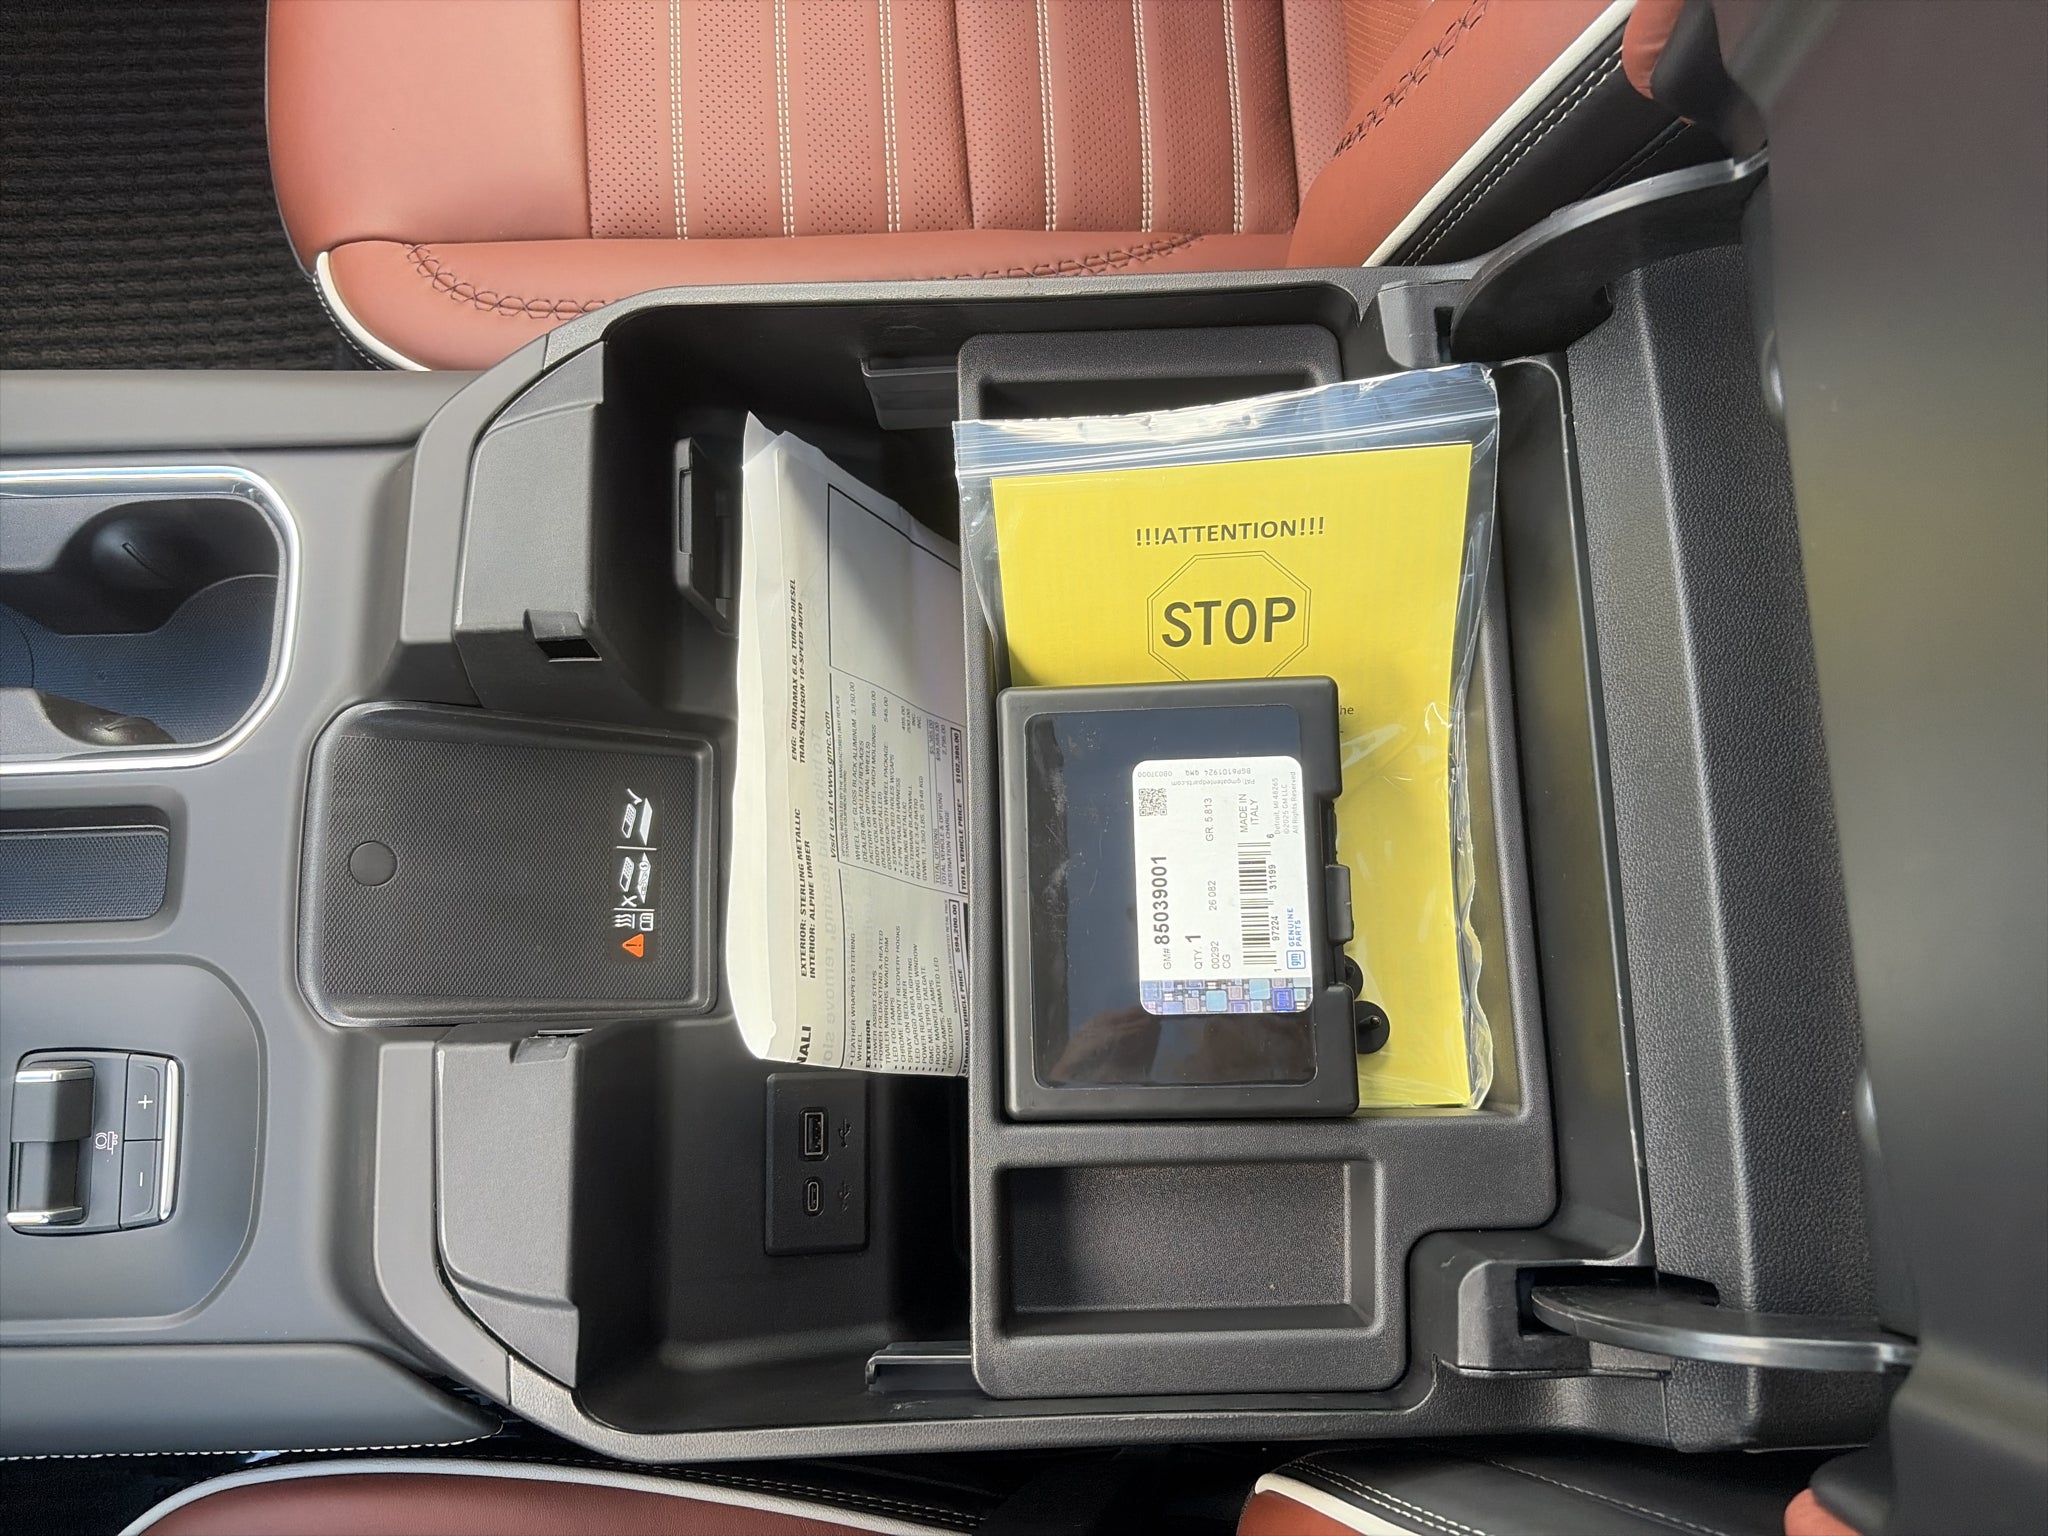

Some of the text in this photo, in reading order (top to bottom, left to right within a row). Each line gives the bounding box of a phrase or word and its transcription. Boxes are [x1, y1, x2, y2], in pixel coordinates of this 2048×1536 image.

[1135, 516, 1325, 547] !!!ATTENTION!!!
[1161, 595, 1297, 648] STOP
[790, 654, 798, 675] 6.6L
[790, 678, 798, 730] DURAMAX
[825, 711, 836, 858] Visit us at www.gmc.com
[1282, 798, 1288, 809] GM
[1289, 771, 1297, 802] Reserved
[867, 816, 871, 827] OR
[1238, 794, 1248, 833] MADE IN
[1250, 798, 1259, 825] ITALY
[1291, 803, 1299, 824] Rights
[794, 808, 803, 860] METALLIC
[860, 830, 868, 862] (DEALER
[884, 807, 892, 870] GOOSENECK/5TH
[804, 840, 813, 878] UMBER
[1268, 864, 1277, 890] 31199
[798, 864, 806, 916] STERLING
[808, 882, 816, 921] ALPINE
[1204, 798, 1220, 969] 00292 26 082 GR. 5.813
[952, 904, 960, 953] $94,200.00
[1150, 856, 1172, 970] GM# 85039001
[1271, 916, 1280, 941] 97224
[1287, 907, 1295, 947] GENUINE
[1184, 934, 1202, 970] QTY. 1
[1222, 954, 1231, 969] CG
[915, 980, 923, 1010] SLIDING
[921, 967, 929, 1001] TAILGATE
[929, 980, 937, 1006] LAMPS
[935, 974, 944, 1013] ANIMATED
[925, 1004, 933, 1043] MULTIPRO
[931, 1008, 940, 1041] MARKER
[960, 996, 968, 1028] VEHICLE
[905, 1022, 913, 1063] SPRAY-ON
[912, 1018, 920, 1045] CARGO
[940, 1015, 948, 1066] HEADLAMPS,
[946, 1017, 954, 1068] PROJECTORS
[961, 1030, 969, 1074] STANDARD
